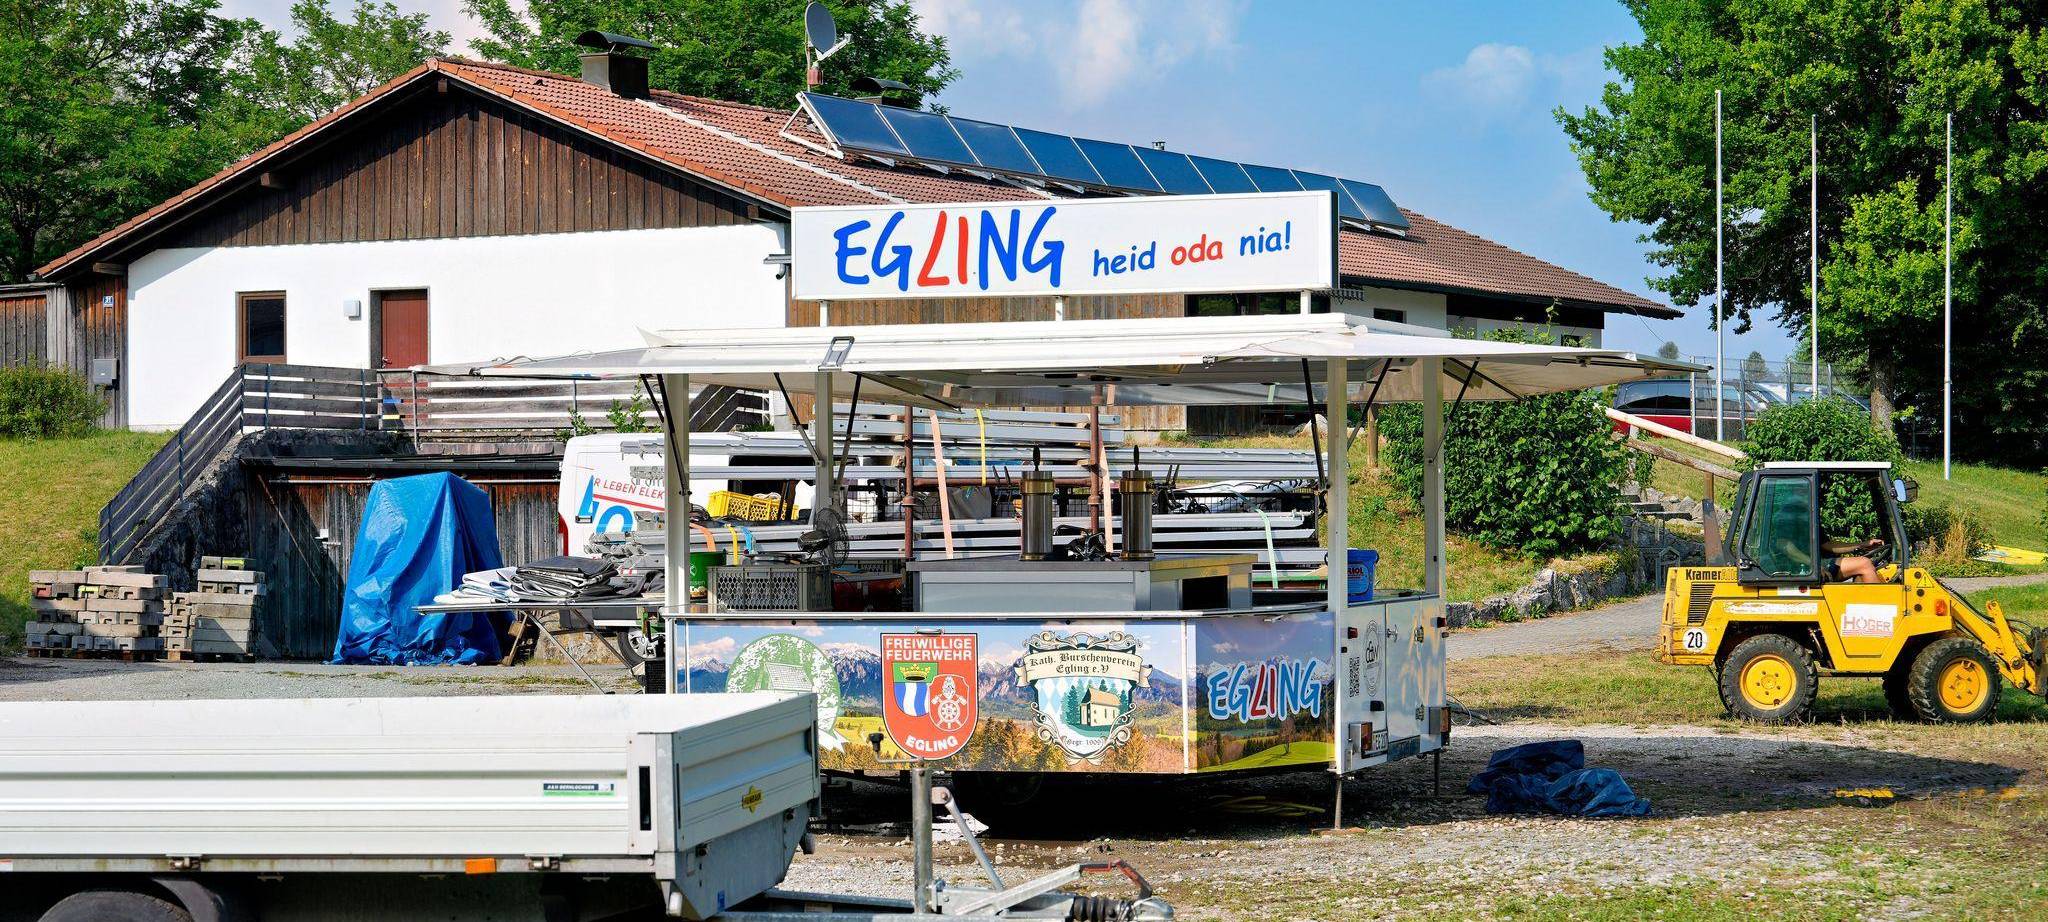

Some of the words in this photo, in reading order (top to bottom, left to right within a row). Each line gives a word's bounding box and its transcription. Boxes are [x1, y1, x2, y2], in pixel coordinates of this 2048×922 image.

[833, 206, 1065, 292] EGLING
[1093, 241, 1156, 277] heid
[1171, 233, 1223, 266] oda
[1240, 221, 1291, 256] nia!
[603, 479, 637, 494] LEBEN
[638, 486, 664, 500] ELEK
[1685, 568, 1722, 581] Kramer
[886, 638, 972, 649] FREIWILLIGE
[1687, 631, 1703, 649] 20
[886, 649, 972, 660] FEUERWEHR
[1030, 657, 1056, 667] Kath.
[1059, 653, 1136, 668] Burschenverein
[1056, 664, 1090, 674] Egling
[1207, 657, 1322, 723] EGLING
[905, 734, 959, 752] EGLING
